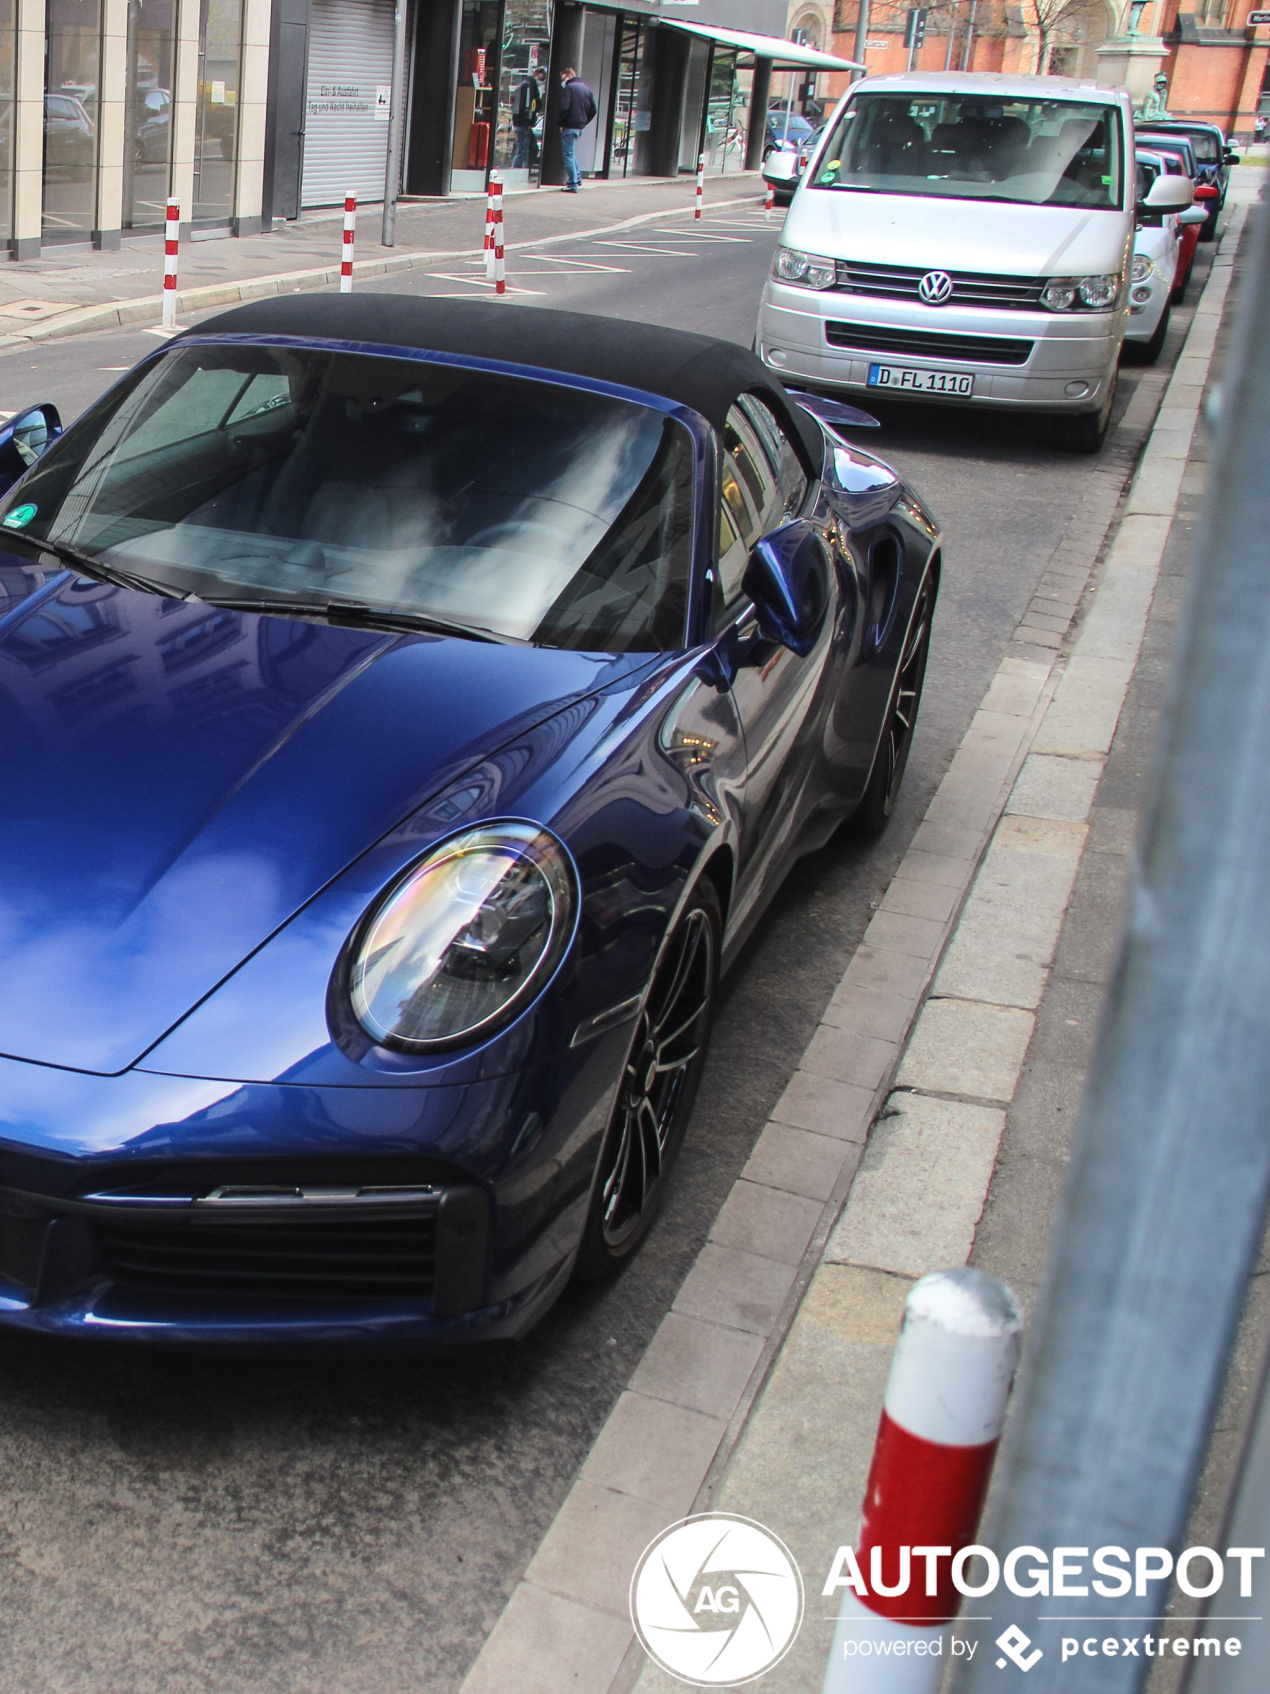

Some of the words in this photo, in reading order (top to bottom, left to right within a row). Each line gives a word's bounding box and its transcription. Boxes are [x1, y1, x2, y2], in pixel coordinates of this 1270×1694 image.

[320, 85, 331, 96] Ein-
[332, 85, 336, 97] &
[337, 86, 359, 97] Ausfahrt
[307, 101, 317, 115] Tag
[318, 102, 328, 112] und
[329, 102, 345, 112] Nacht
[346, 102, 369, 112] freihalten
[878, 368, 891, 385] D
[900, 371, 923, 388] FL
[926, 375, 970, 393] 1110
